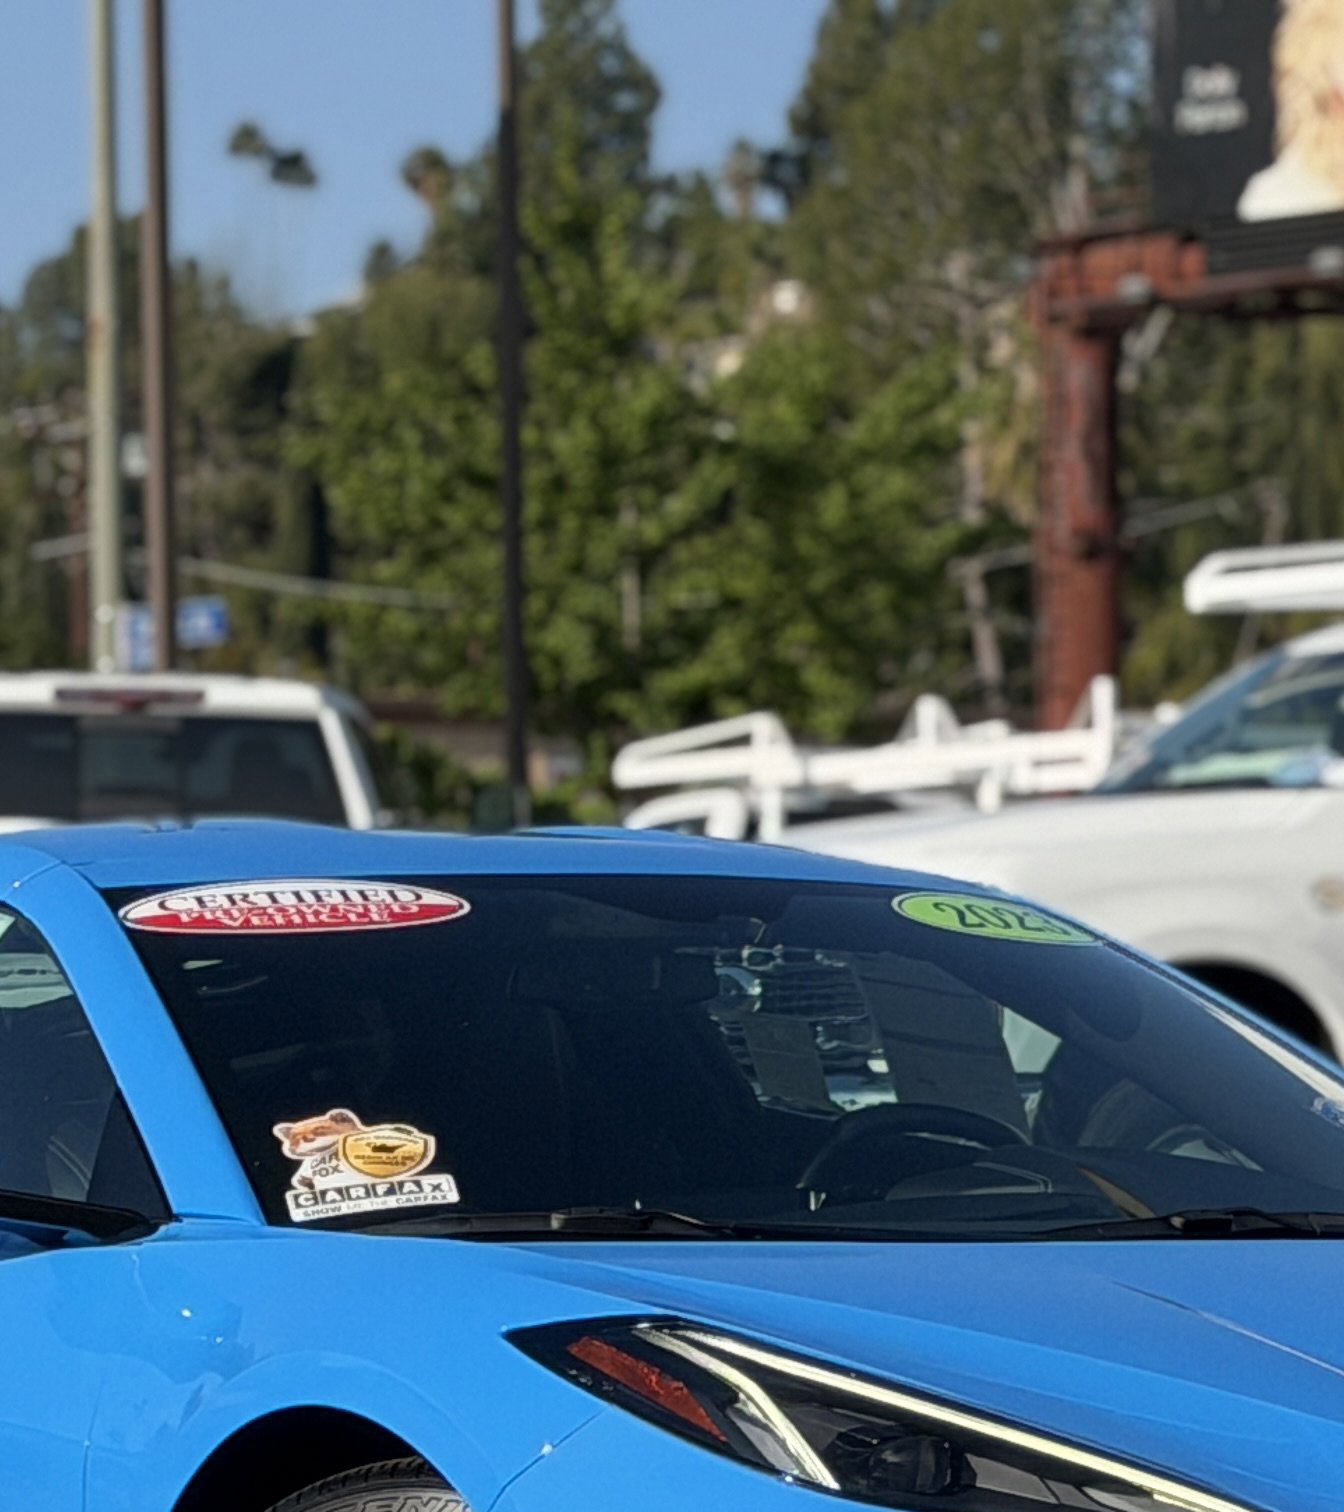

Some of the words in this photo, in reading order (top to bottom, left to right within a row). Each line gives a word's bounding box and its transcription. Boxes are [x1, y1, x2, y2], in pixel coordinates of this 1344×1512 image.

[157, 890, 424, 913] CERTIFIED
[219, 911, 393, 926] VEHICLE
[310, 1150, 341, 1170] CAR
[311, 1163, 345, 1178] FOX
[294, 1180, 449, 1209] CARFAX
